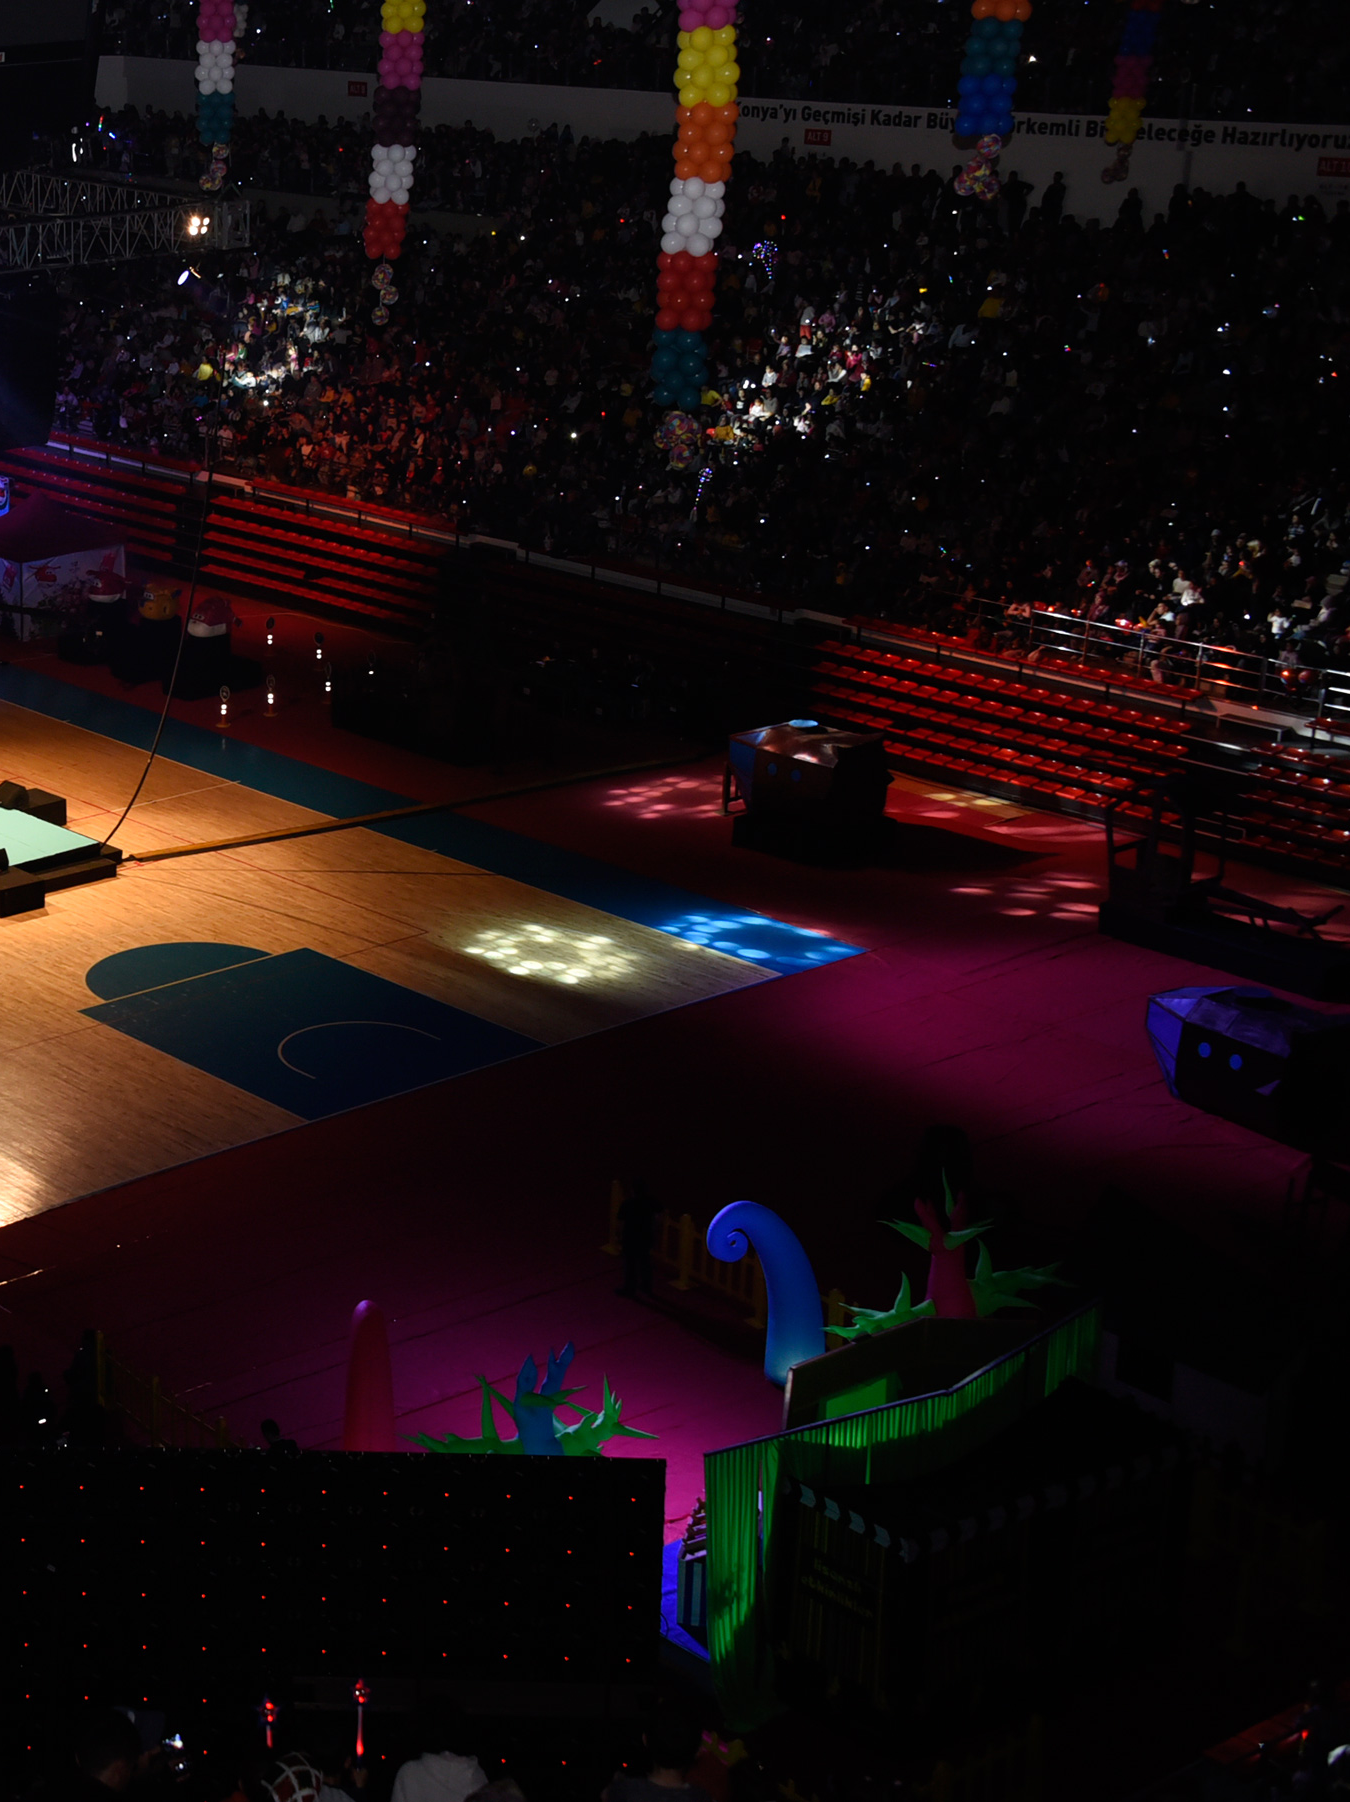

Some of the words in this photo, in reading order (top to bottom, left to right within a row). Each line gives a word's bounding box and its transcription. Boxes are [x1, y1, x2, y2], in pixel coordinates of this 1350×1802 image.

[801, 106, 866, 127] Geçmişi
[871, 110, 921, 128] Kadar
[1086, 120, 1108, 138] Bi
[1136, 122, 1216, 147] eleceğe
[807, 130, 822, 142] ALT
